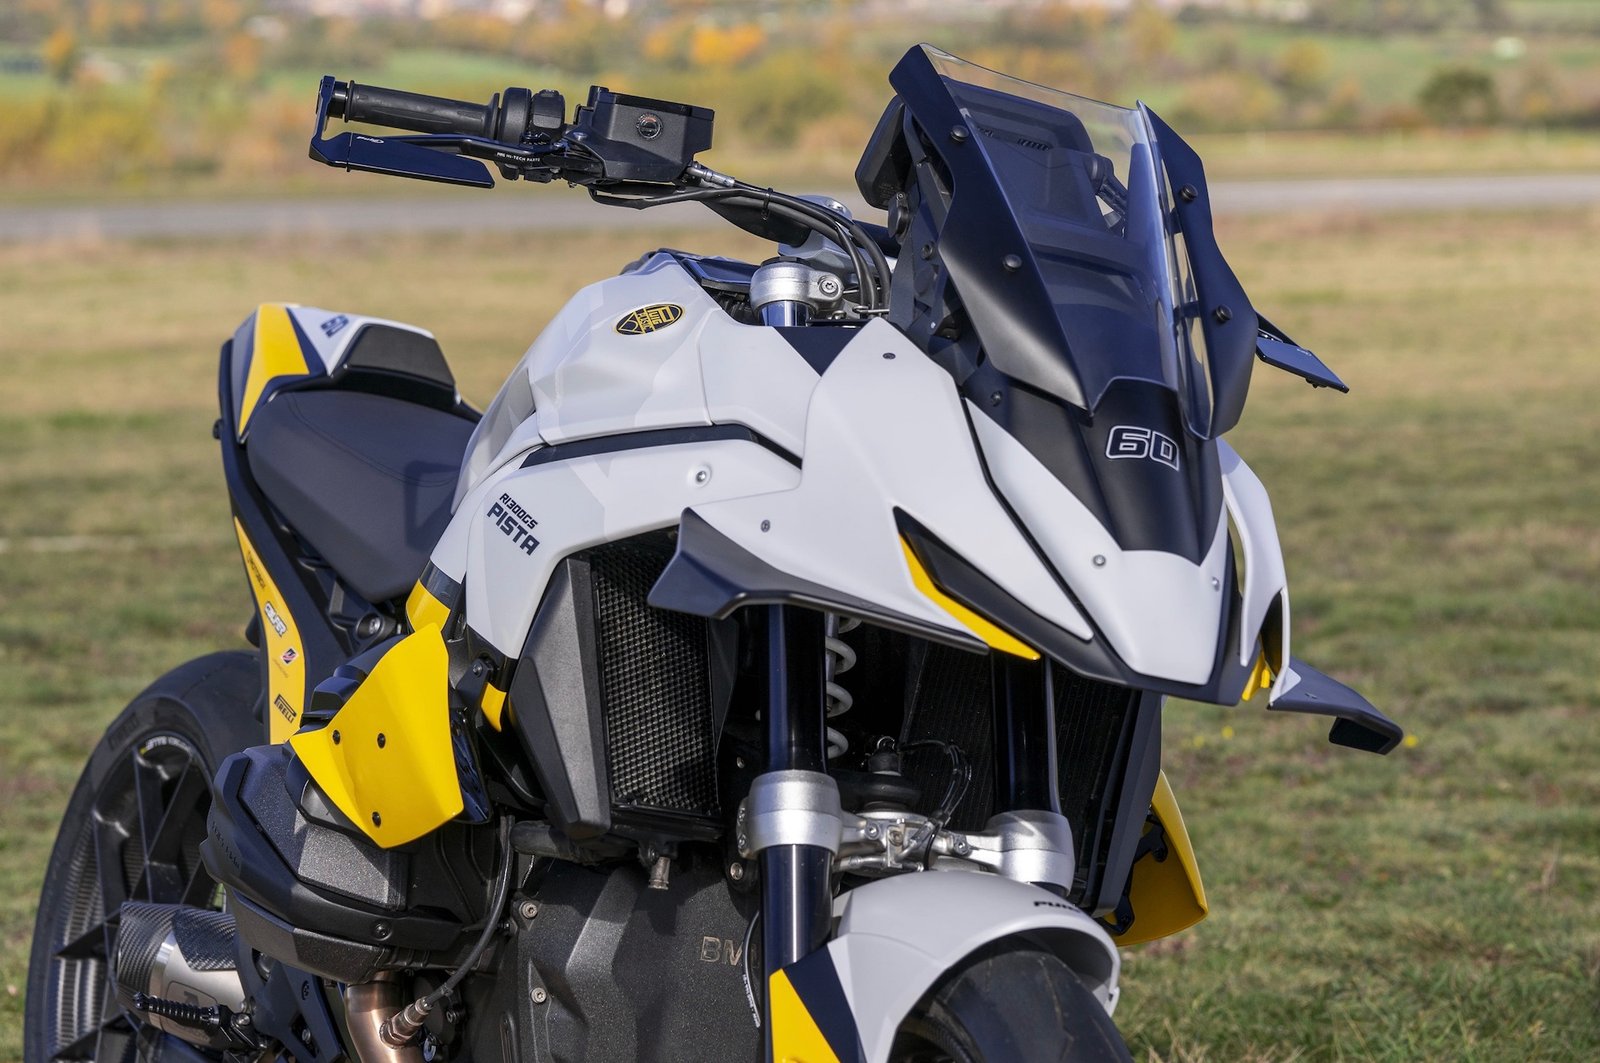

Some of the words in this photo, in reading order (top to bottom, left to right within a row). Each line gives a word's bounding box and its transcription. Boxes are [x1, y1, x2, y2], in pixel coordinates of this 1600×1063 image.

[1105, 425, 1179, 472] 60
[486, 502, 540, 556] PISTA
[273, 694, 297, 724] PIRELLI
[700, 936, 747, 966] BM
